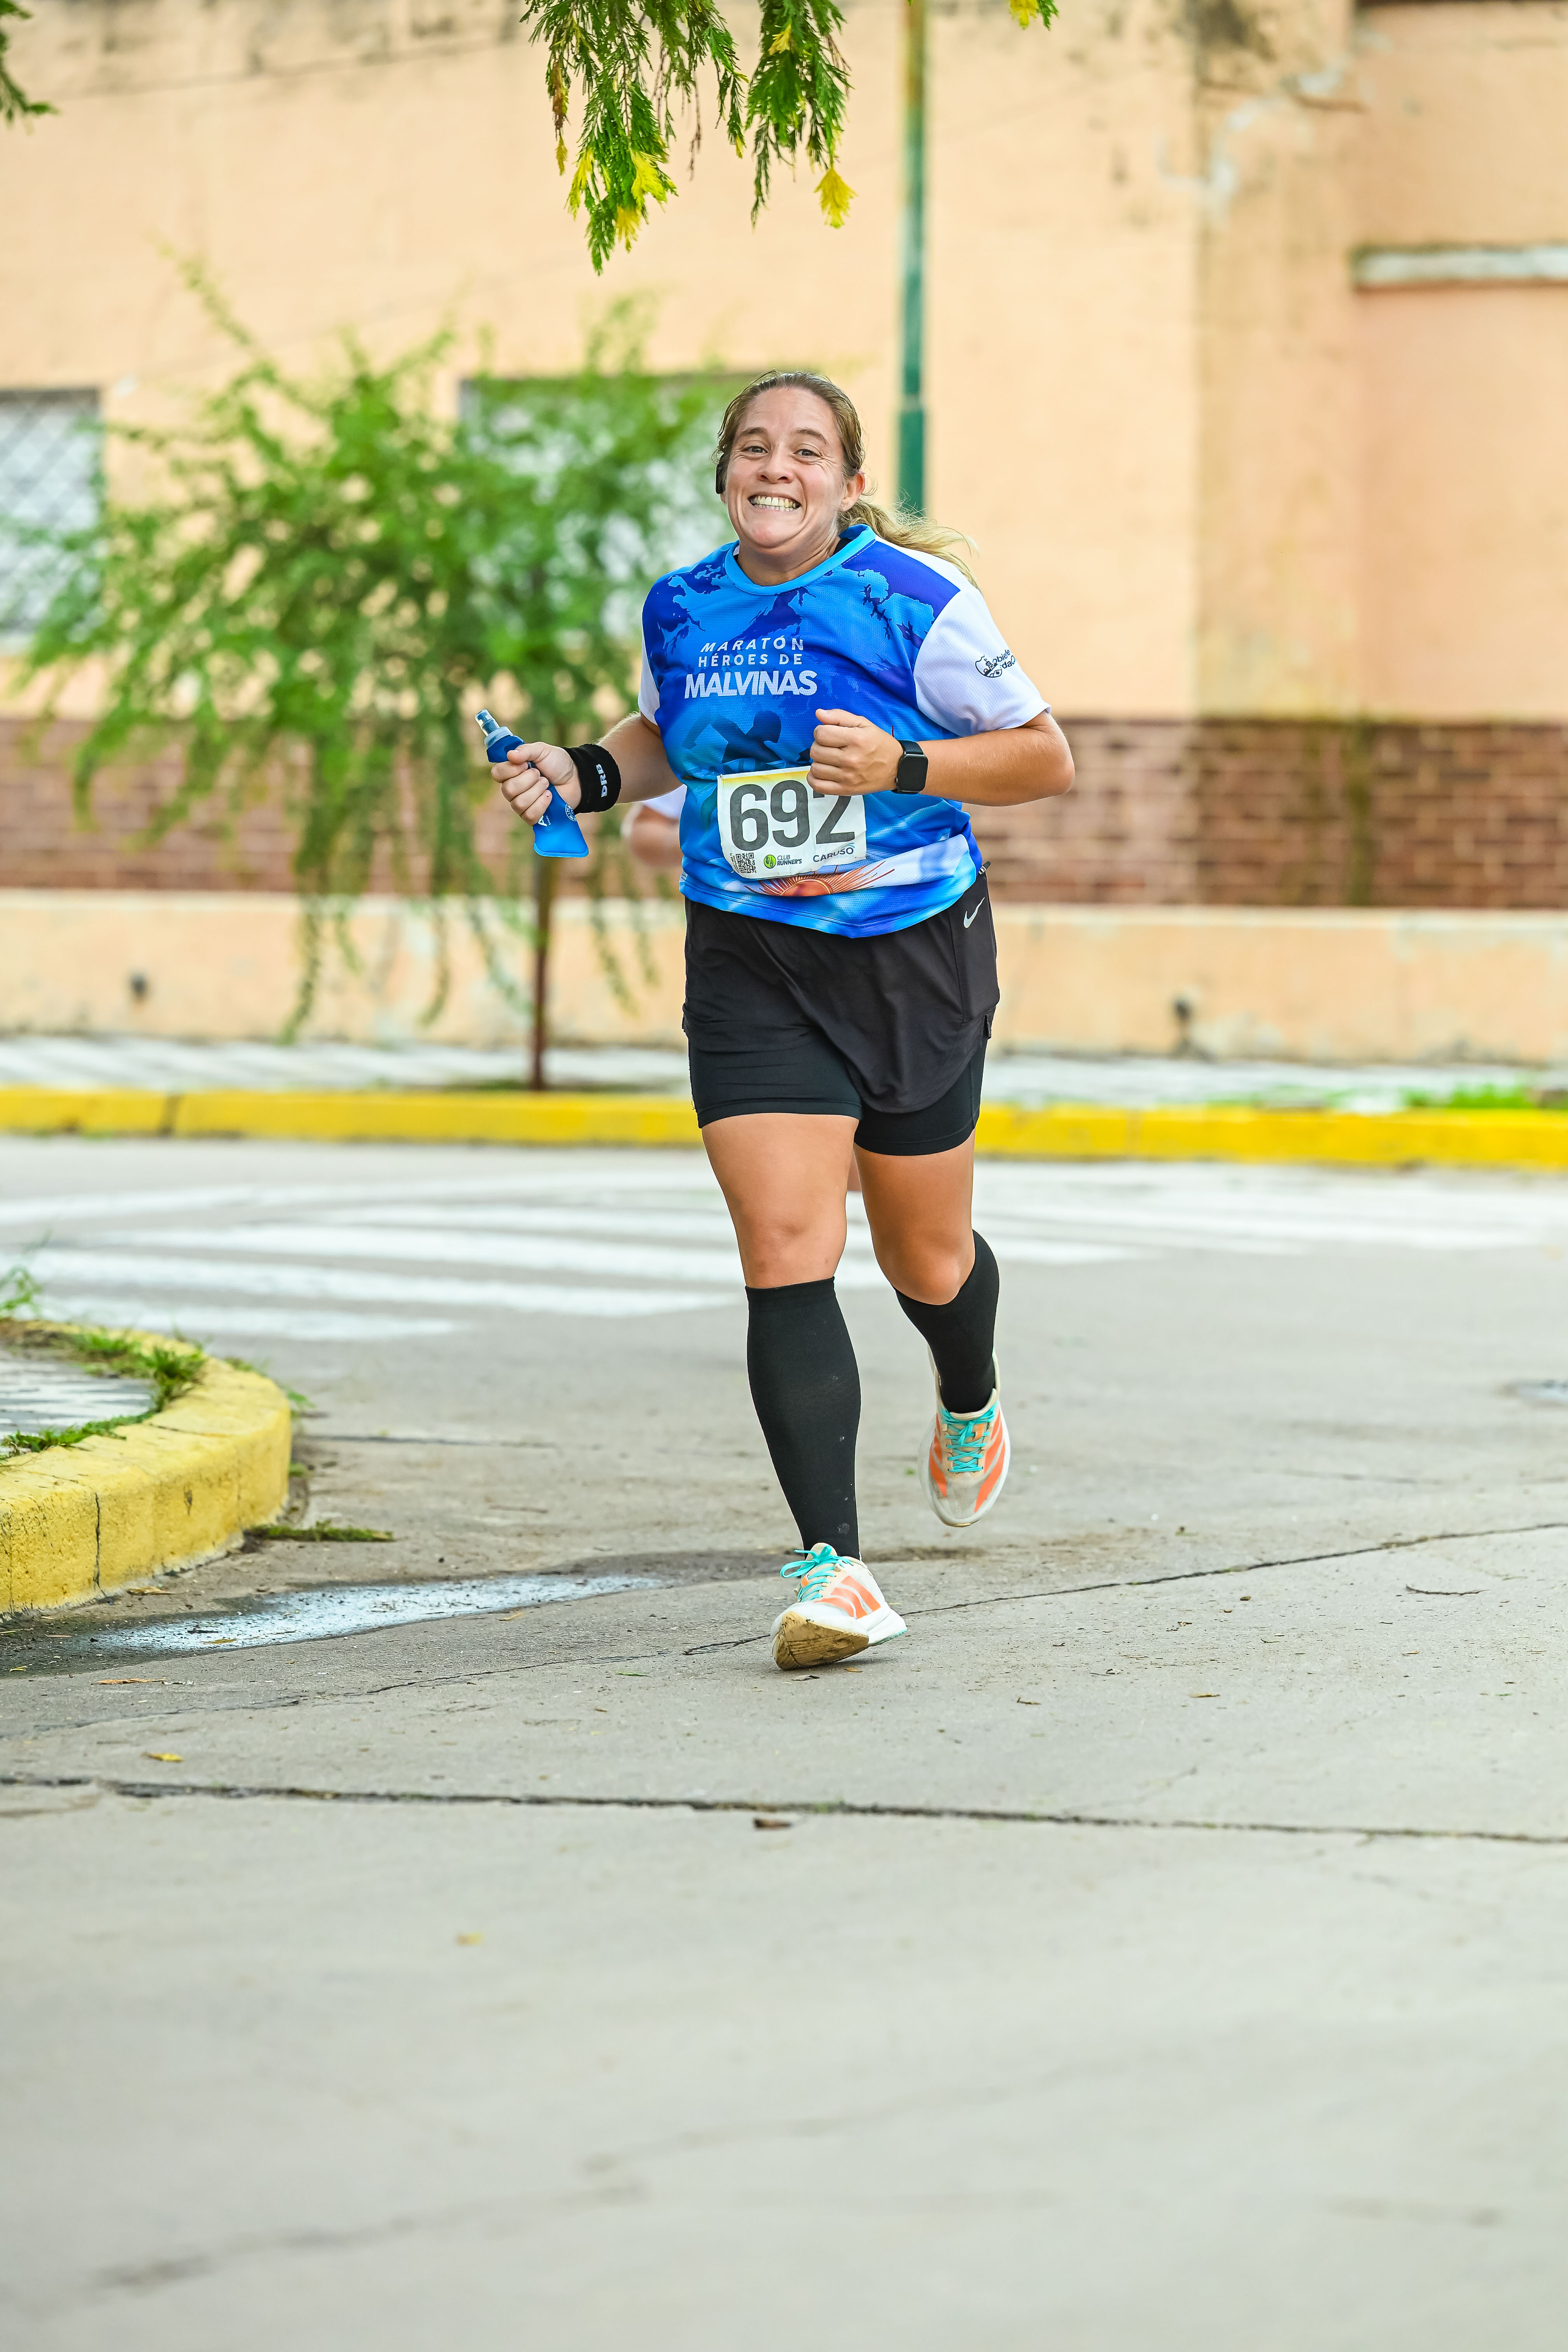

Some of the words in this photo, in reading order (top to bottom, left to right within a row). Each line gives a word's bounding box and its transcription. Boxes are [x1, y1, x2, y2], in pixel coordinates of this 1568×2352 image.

[700, 635, 803, 653] MARATÓN
[698, 653, 768, 667] HÉROES
[779, 654, 802, 665] DE
[684, 670, 817, 698] MALVINAS
[730, 780, 855, 851] 692
[813, 847, 854, 862] CARUSO
